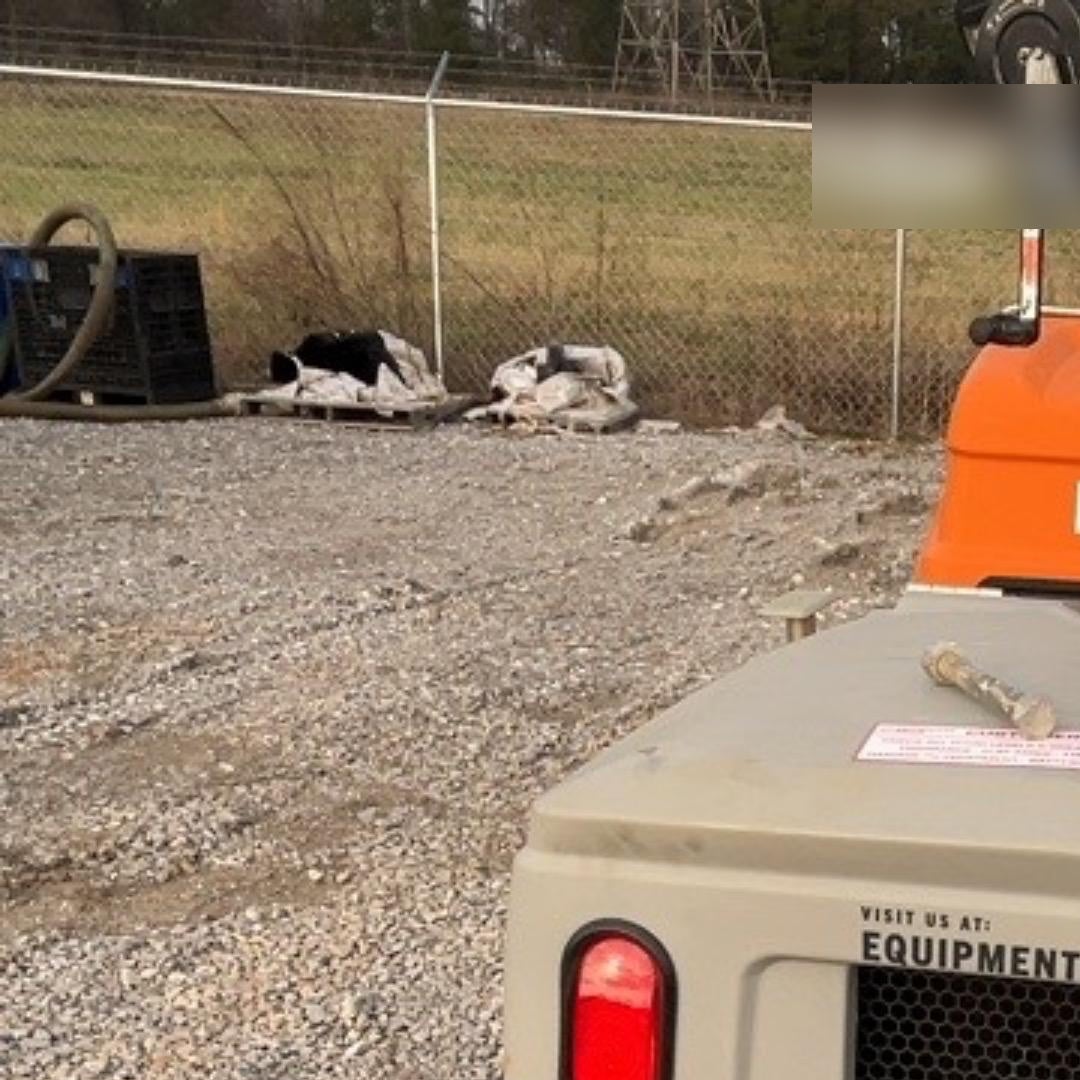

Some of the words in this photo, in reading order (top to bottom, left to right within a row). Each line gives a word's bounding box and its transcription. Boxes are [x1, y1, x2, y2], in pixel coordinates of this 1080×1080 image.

[860, 905, 914, 926] VISIT
[924, 911, 950, 930] US
[959, 915, 992, 932] AT:
